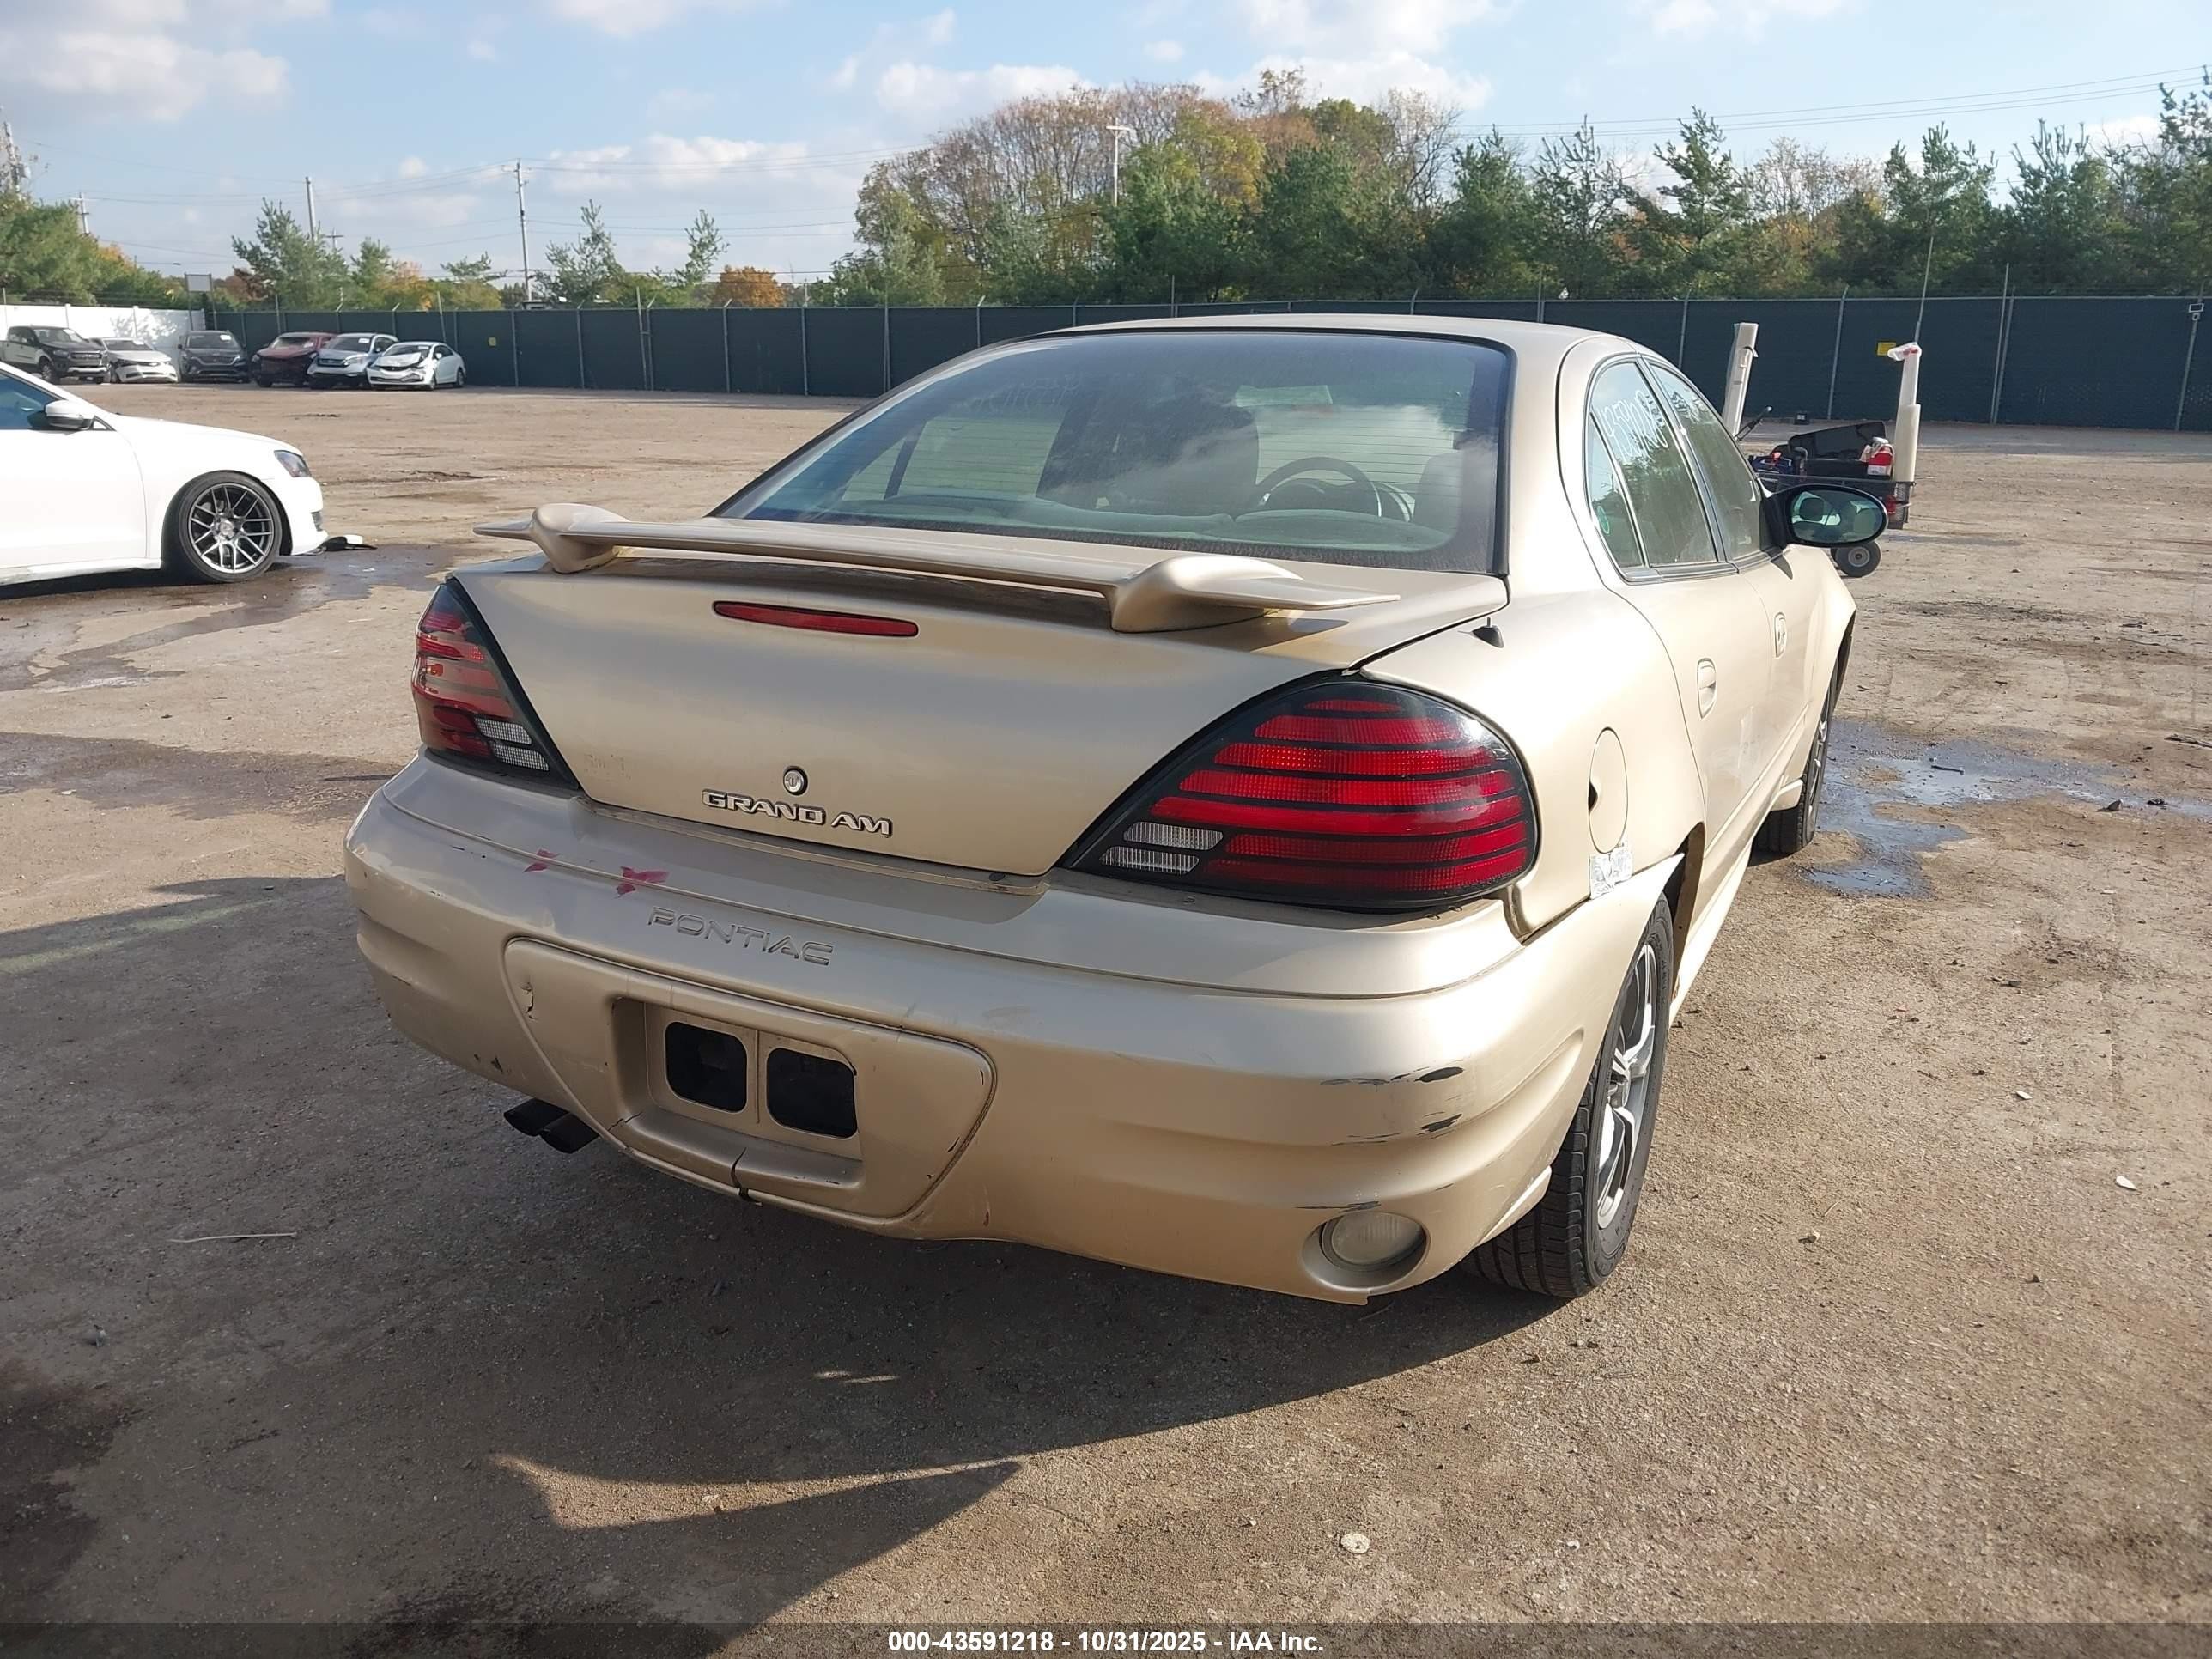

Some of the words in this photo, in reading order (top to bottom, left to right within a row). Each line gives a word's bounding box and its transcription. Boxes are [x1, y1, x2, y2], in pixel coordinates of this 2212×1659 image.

[701, 788, 826, 825] GRAND
[830, 811, 893, 837] AM
[647, 906, 835, 967] PONTIAC
